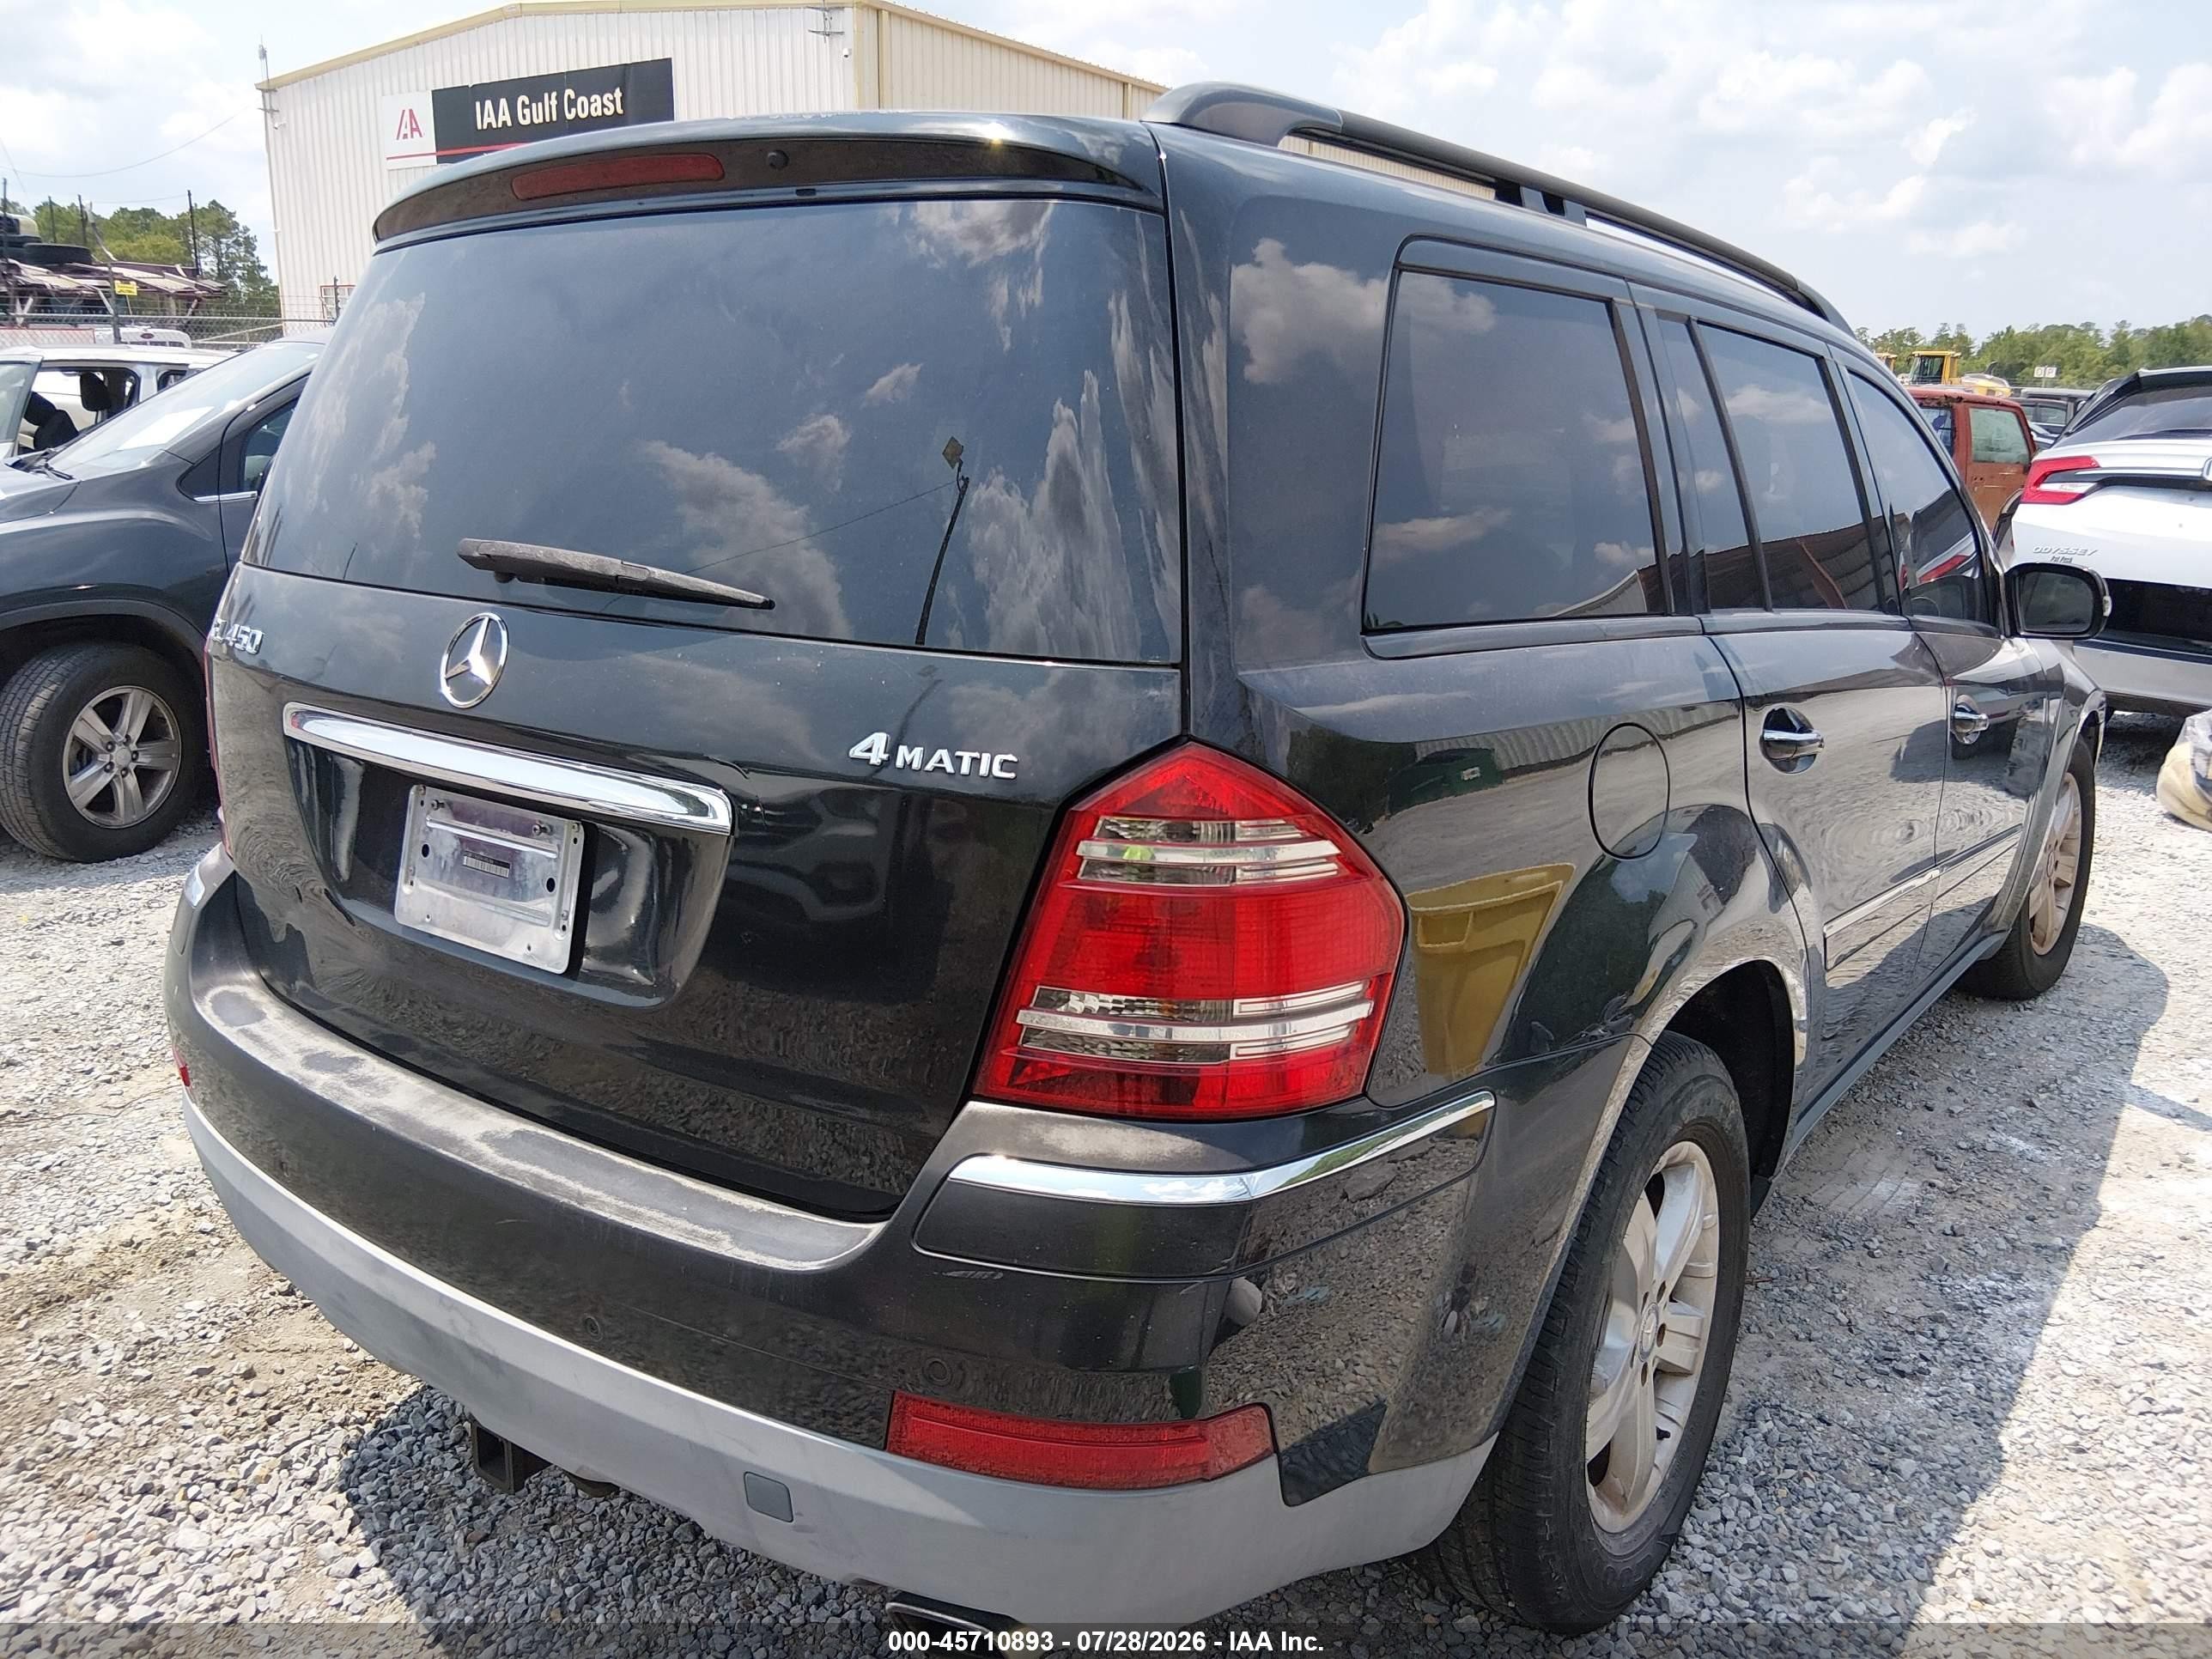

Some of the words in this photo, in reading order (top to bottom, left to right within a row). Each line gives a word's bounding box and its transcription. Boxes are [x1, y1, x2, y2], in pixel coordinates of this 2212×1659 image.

[475, 98, 513, 131] IAA
[517, 91, 557, 126] Gulf
[563, 87, 624, 120] Coast
[2033, 545, 2098, 556] ODYSSEY
